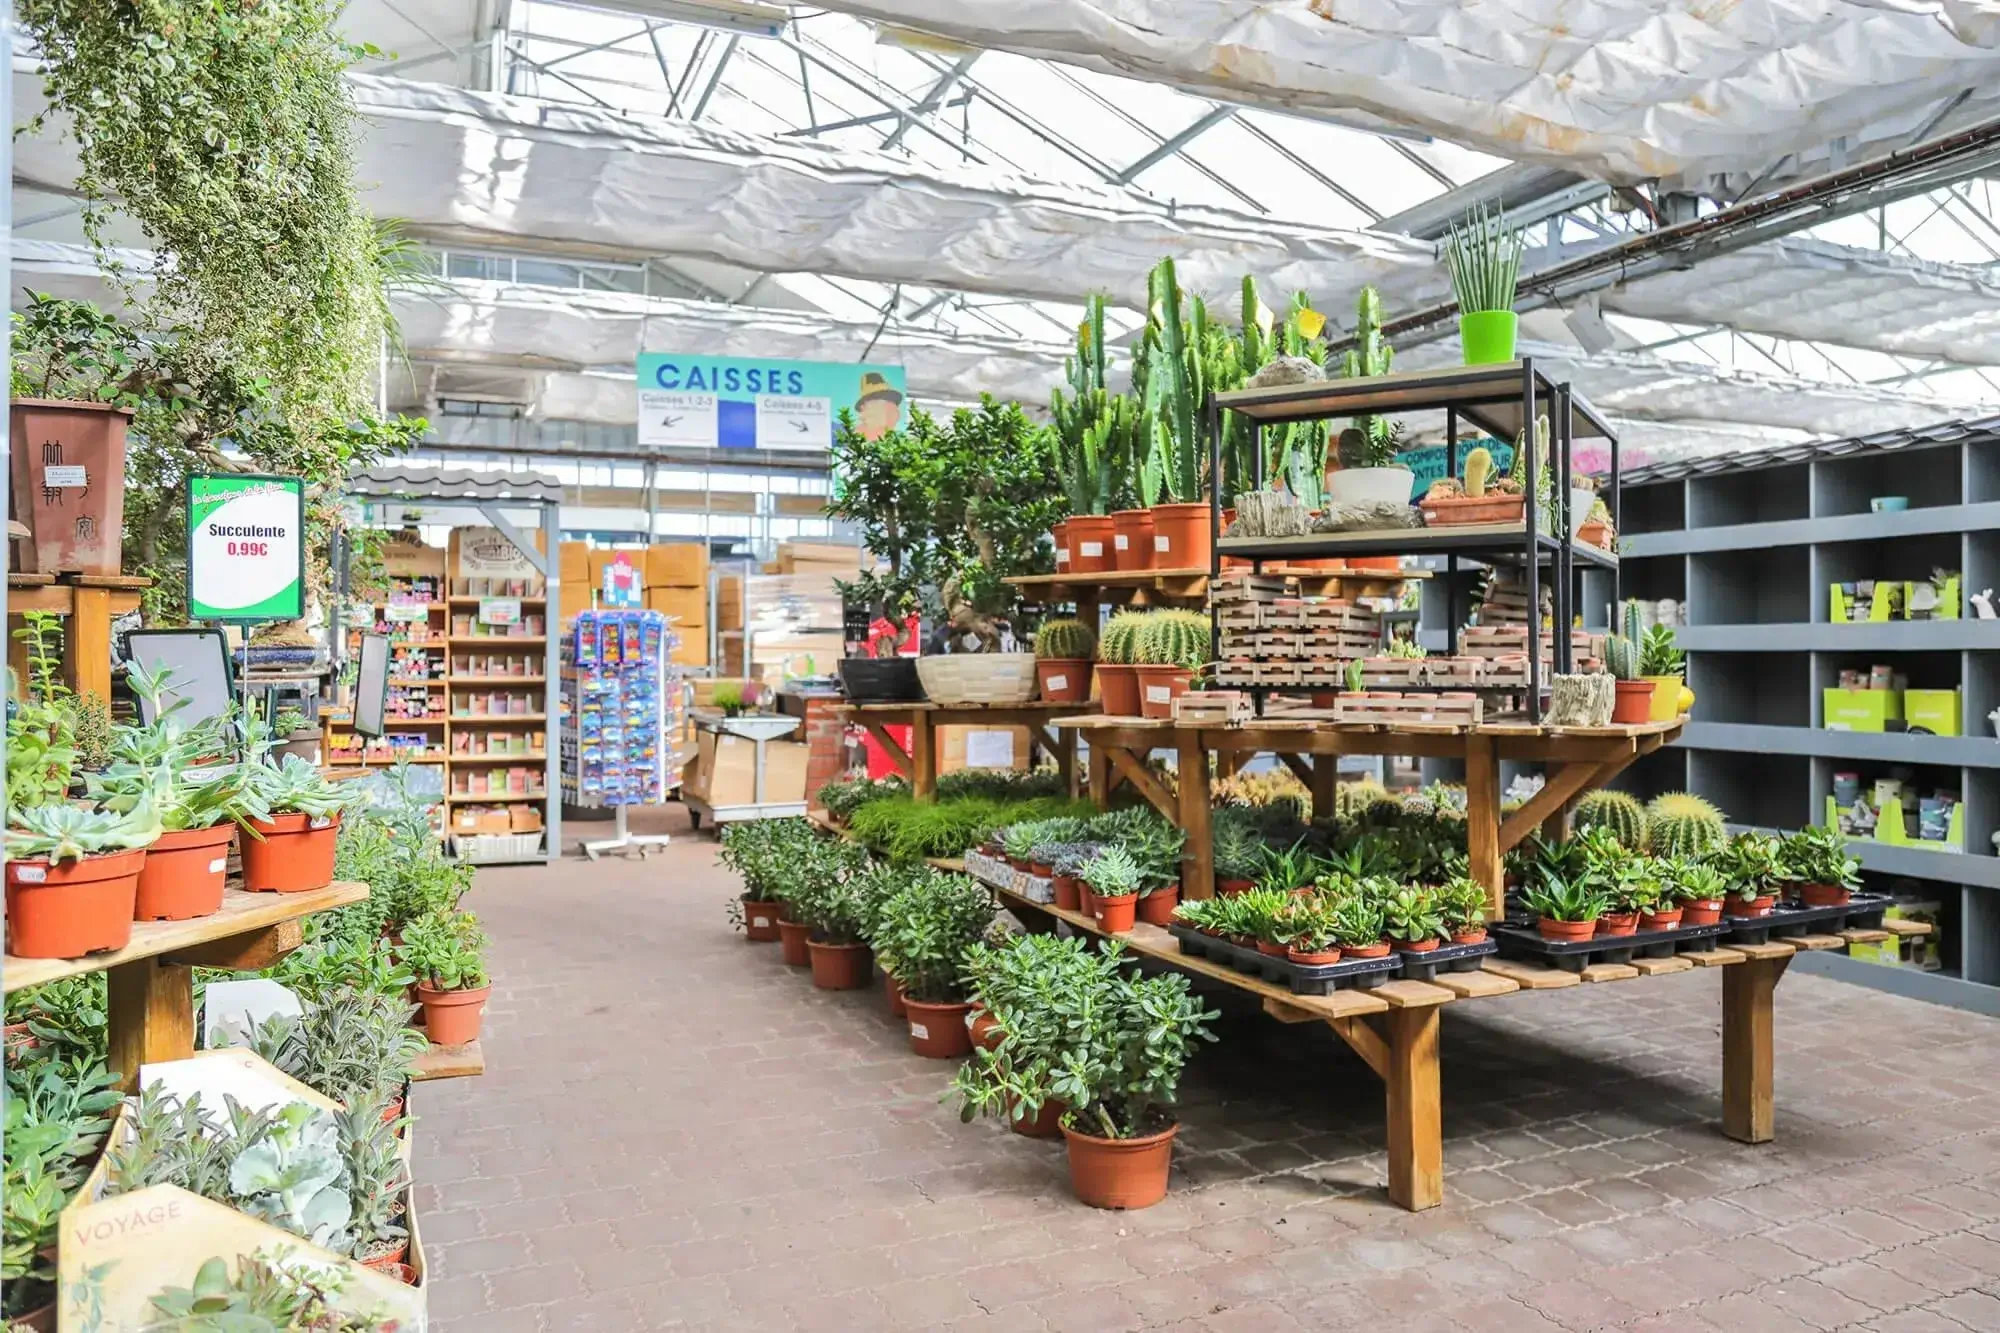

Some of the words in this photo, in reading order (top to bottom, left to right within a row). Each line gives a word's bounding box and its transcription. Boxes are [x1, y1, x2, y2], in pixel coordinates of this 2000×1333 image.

[655, 363, 804, 395] CAISSES
[641, 393, 685, 405] Caisses
[763, 398, 804, 410] Caisses
[209, 523, 285, 537] Succulente
[75, 1201, 181, 1247] VOYAGE
